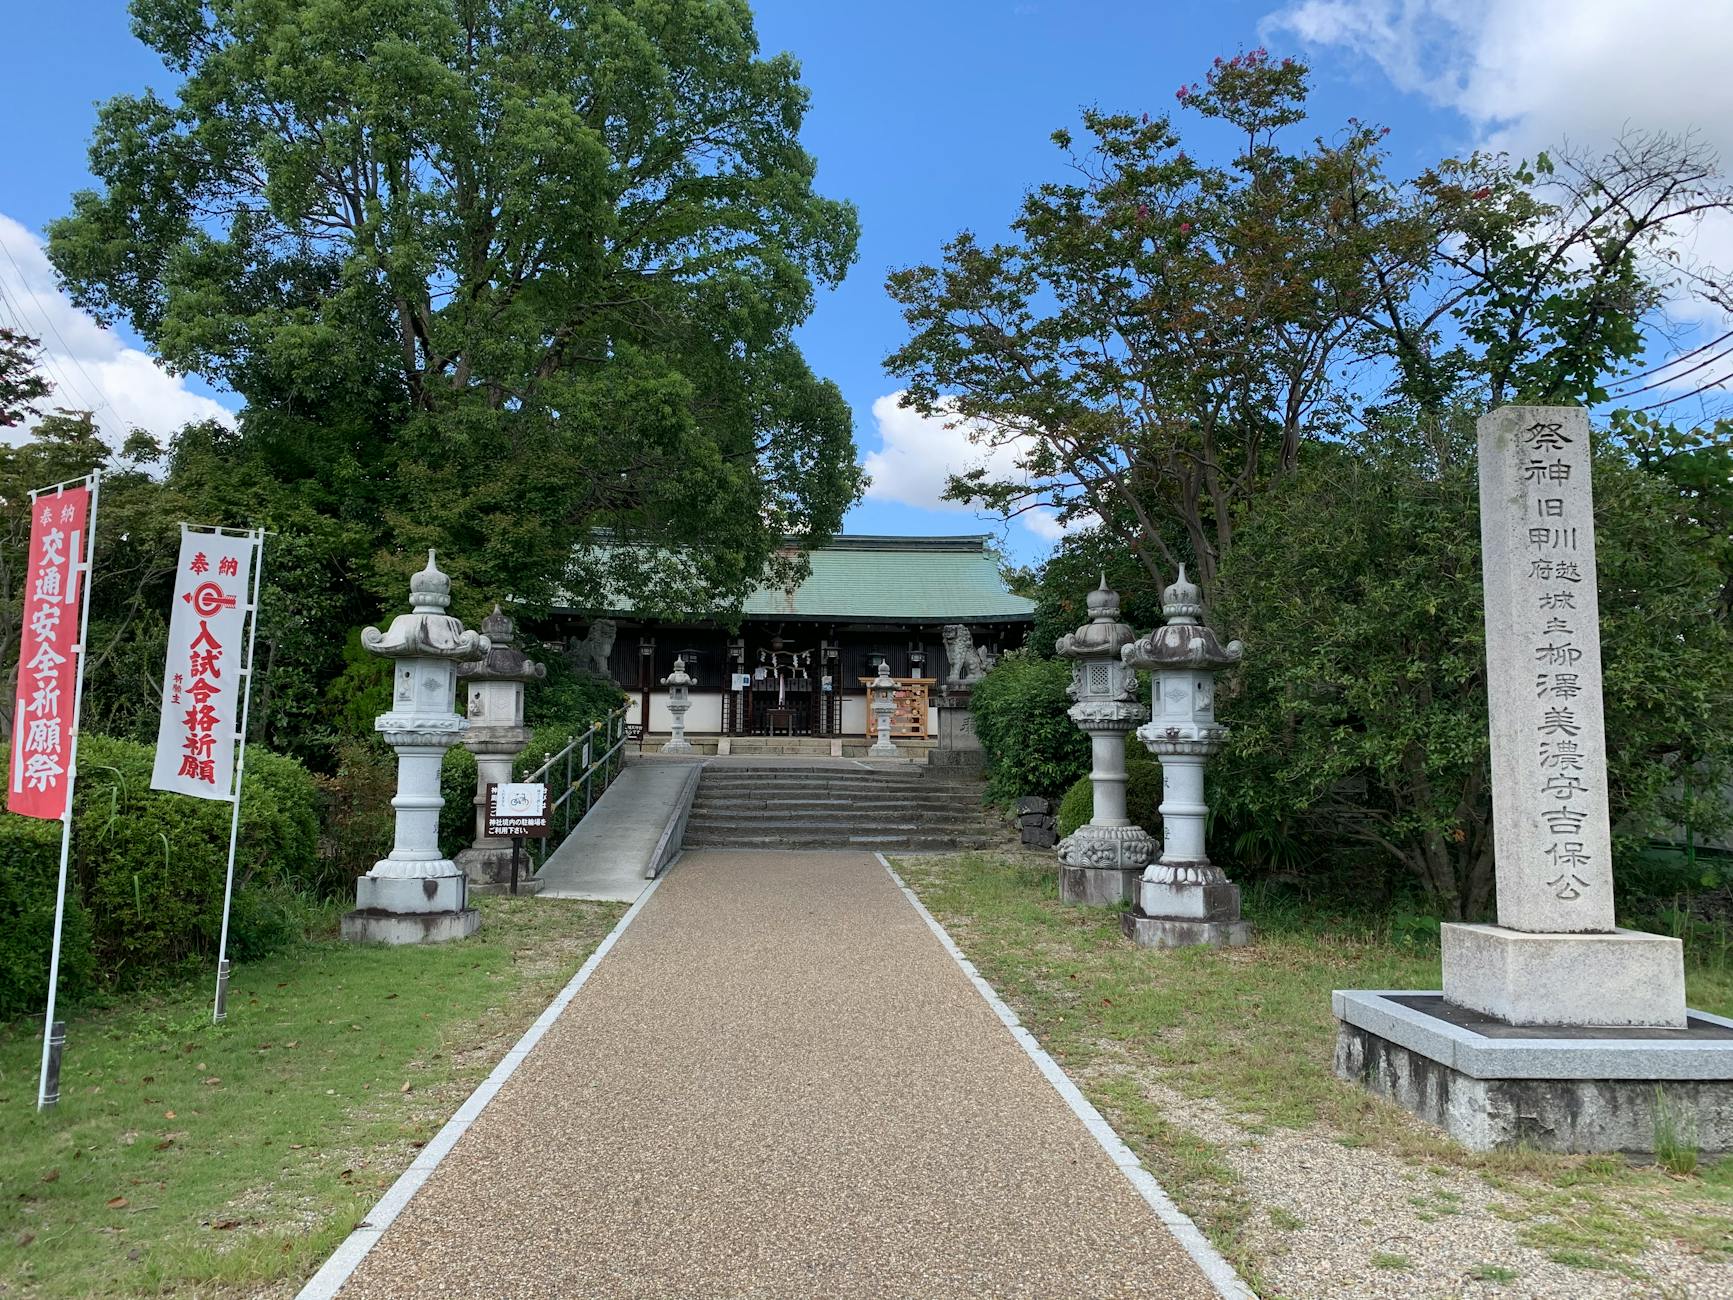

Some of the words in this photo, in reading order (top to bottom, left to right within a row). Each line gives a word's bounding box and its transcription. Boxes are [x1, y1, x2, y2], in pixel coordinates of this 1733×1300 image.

[40, 504, 75, 526] 奉納
[190, 551, 238, 576] 奉納
[24, 527, 66, 792] 交通安全祈願祭
[178, 620, 223, 784] 入試合格祈願
